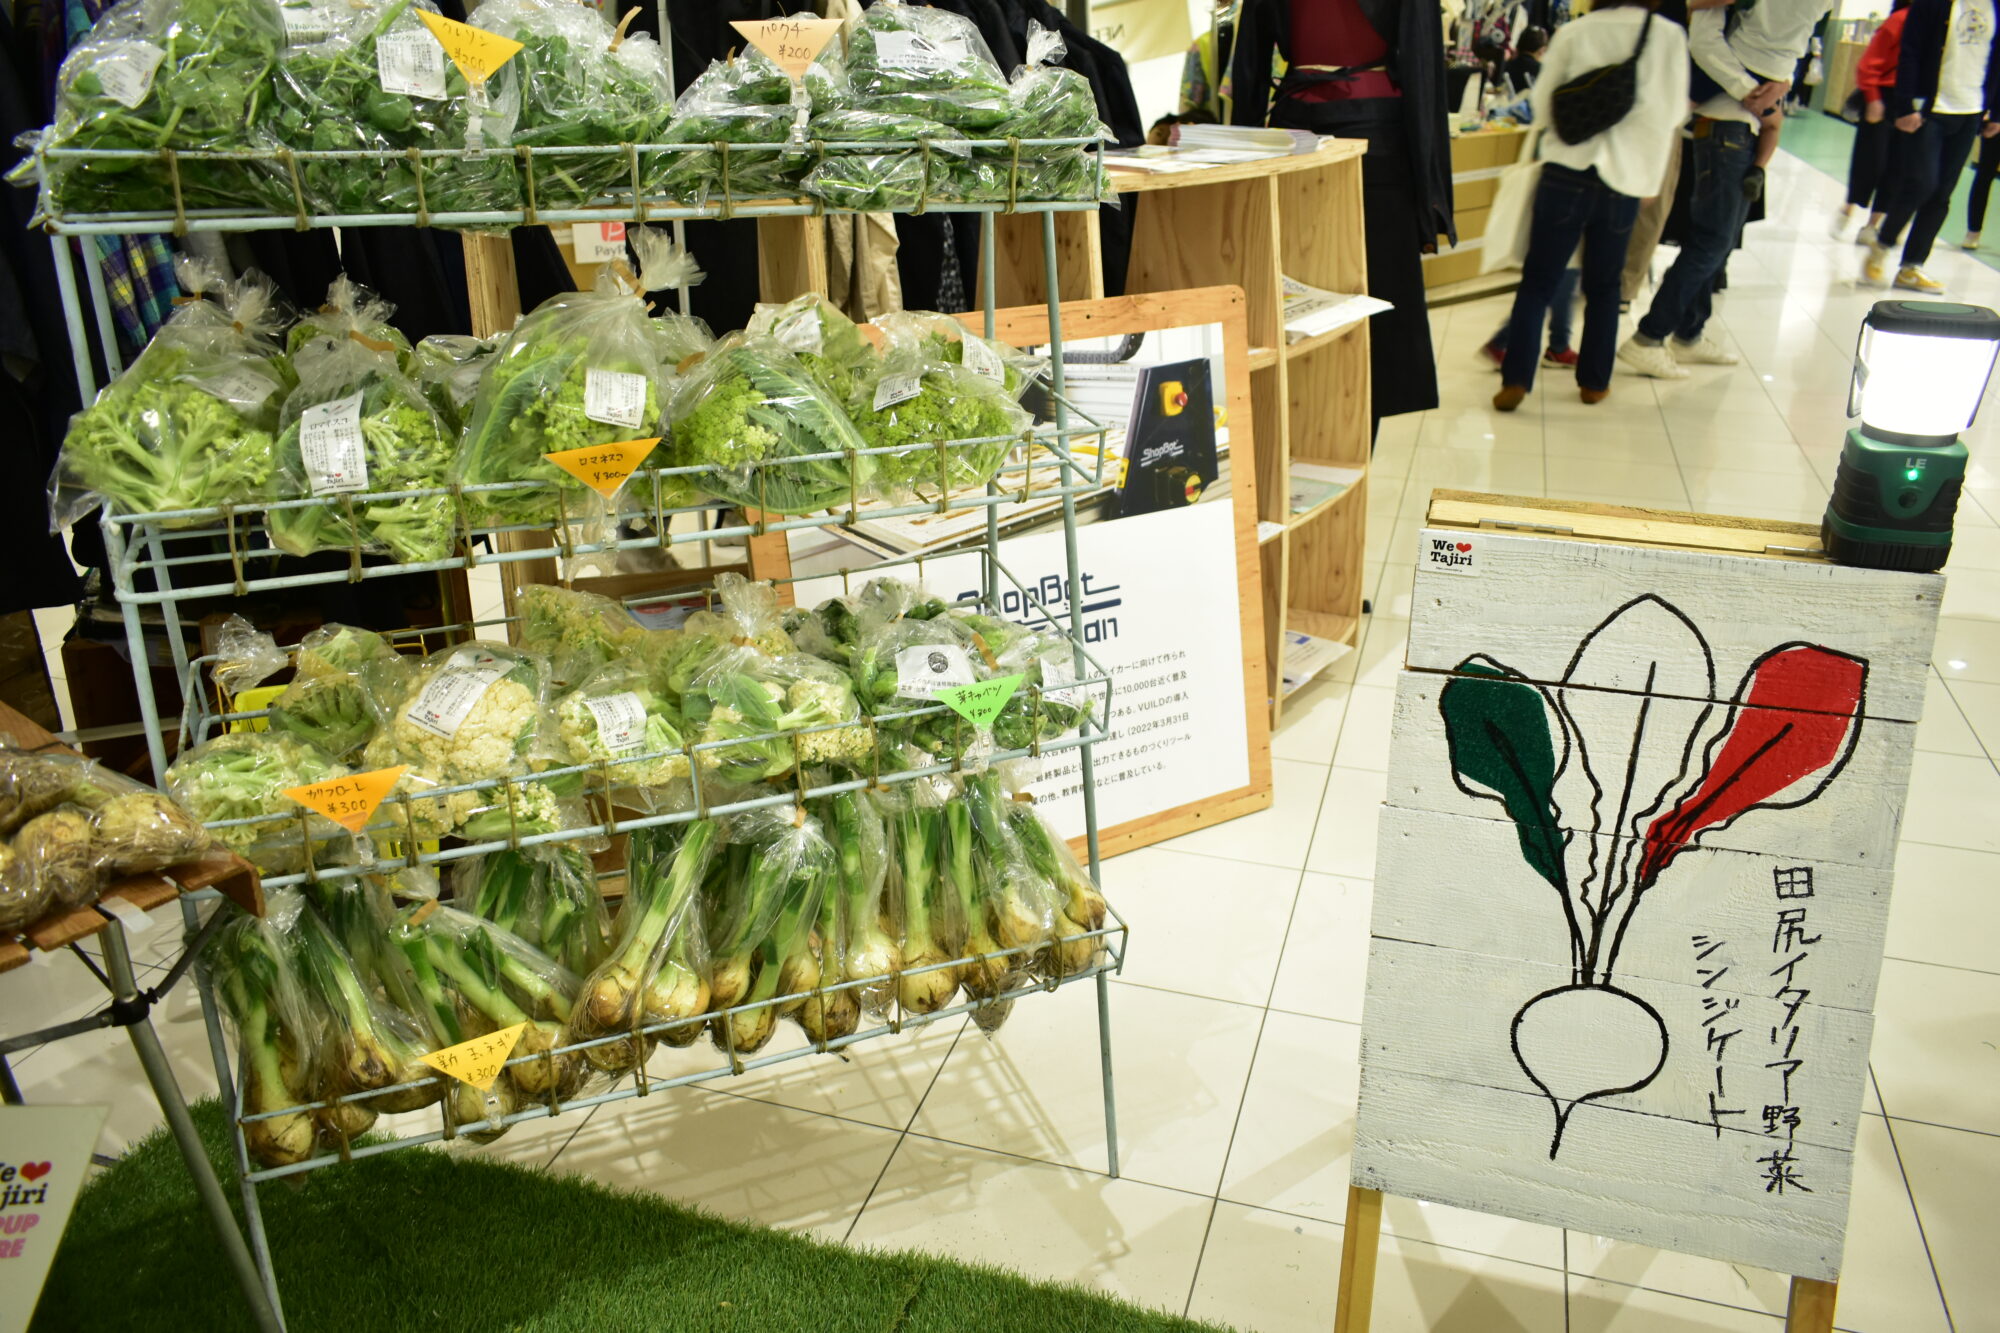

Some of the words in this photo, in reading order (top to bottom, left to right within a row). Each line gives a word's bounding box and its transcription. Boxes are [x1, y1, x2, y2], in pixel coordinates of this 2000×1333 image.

[761, 22, 812, 40] パクチー
[778, 44, 811, 60] ¥200
[578, 452, 625, 467] ロマネスコ
[1905, 457, 1927, 469] LE
[1432, 539, 1455, 551] We
[1430, 551, 1473, 567] Tajiri
[327, 799, 368, 815] ¥300
[1692, 935, 1747, 1140] シンジケート
[1756, 865, 1823, 1195] 田尻イタリア野菜
[466, 1064, 497, 1082] ¥300
